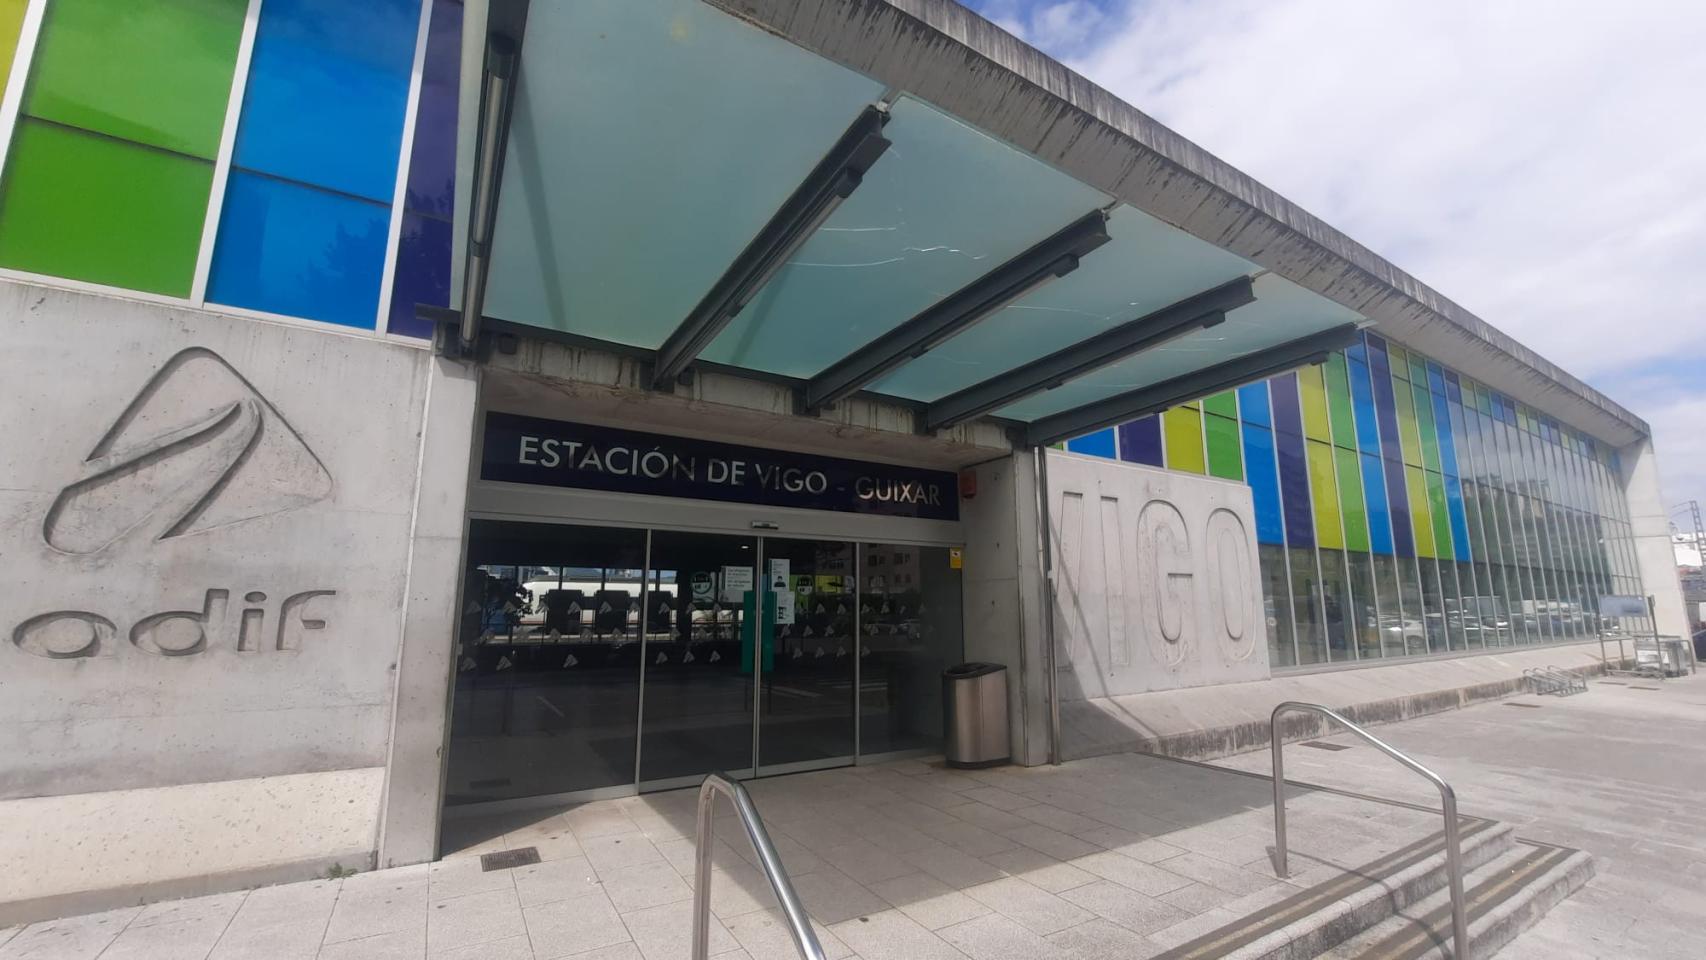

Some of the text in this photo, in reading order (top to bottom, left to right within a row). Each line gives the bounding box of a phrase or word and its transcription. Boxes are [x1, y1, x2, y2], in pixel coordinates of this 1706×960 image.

[519, 435, 696, 481] ESTACIÓN
[707, 458, 746, 487] DE
[755, 463, 827, 494] VIGO
[855, 476, 941, 506] GUIXAR
[12, 588, 337, 660] adif
